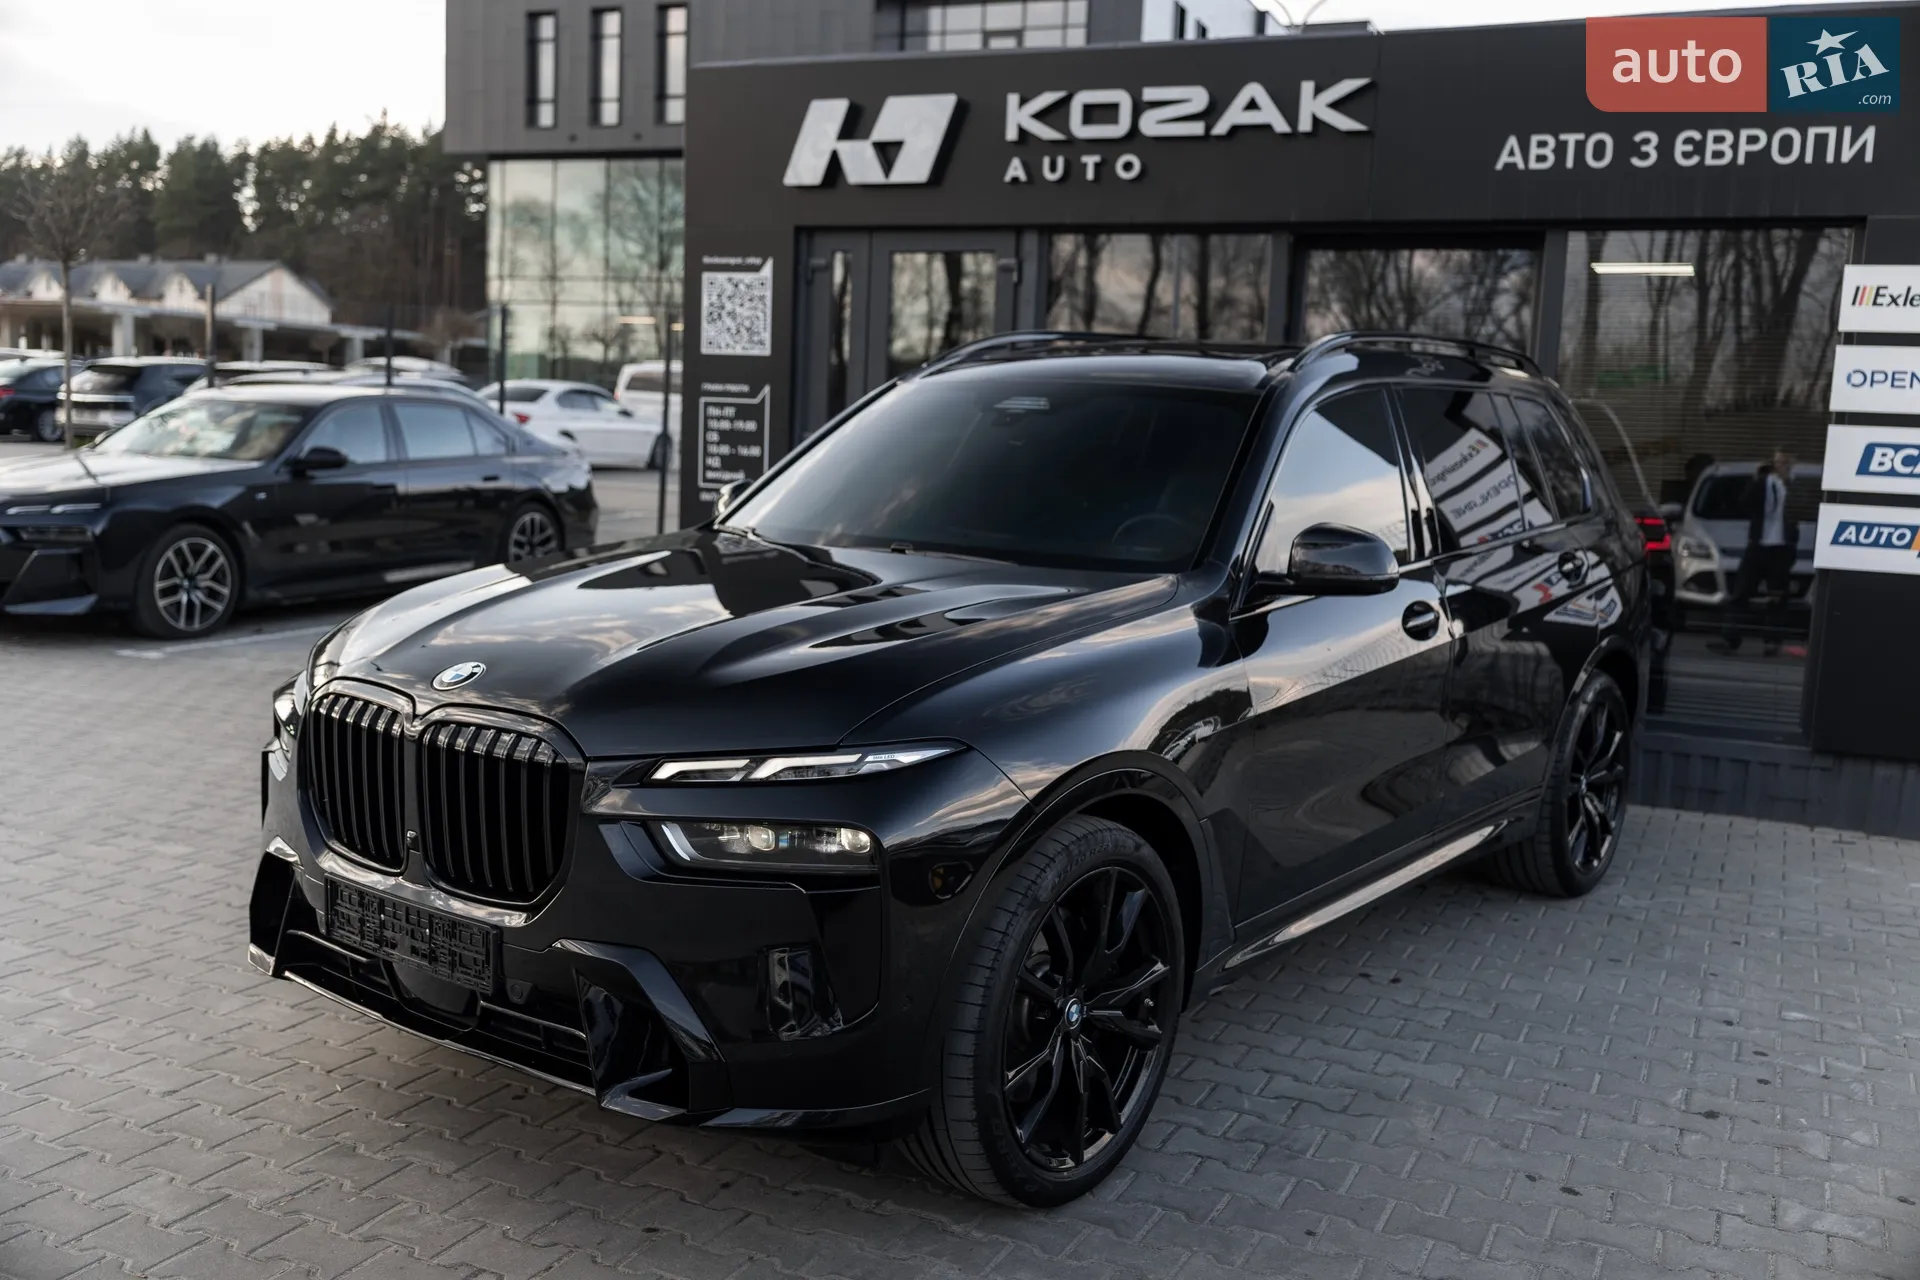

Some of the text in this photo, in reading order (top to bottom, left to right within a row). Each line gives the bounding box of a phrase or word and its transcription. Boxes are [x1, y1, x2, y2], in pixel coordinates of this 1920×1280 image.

[1005, 77, 1373, 143] KOZAK
[1495, 132, 1615, 171] АВТО
[1673, 125, 1877, 167] ЄВРОПИ
[1003, 153, 1143, 183] AUTO
[1838, 524, 1912, 547] AUTO
